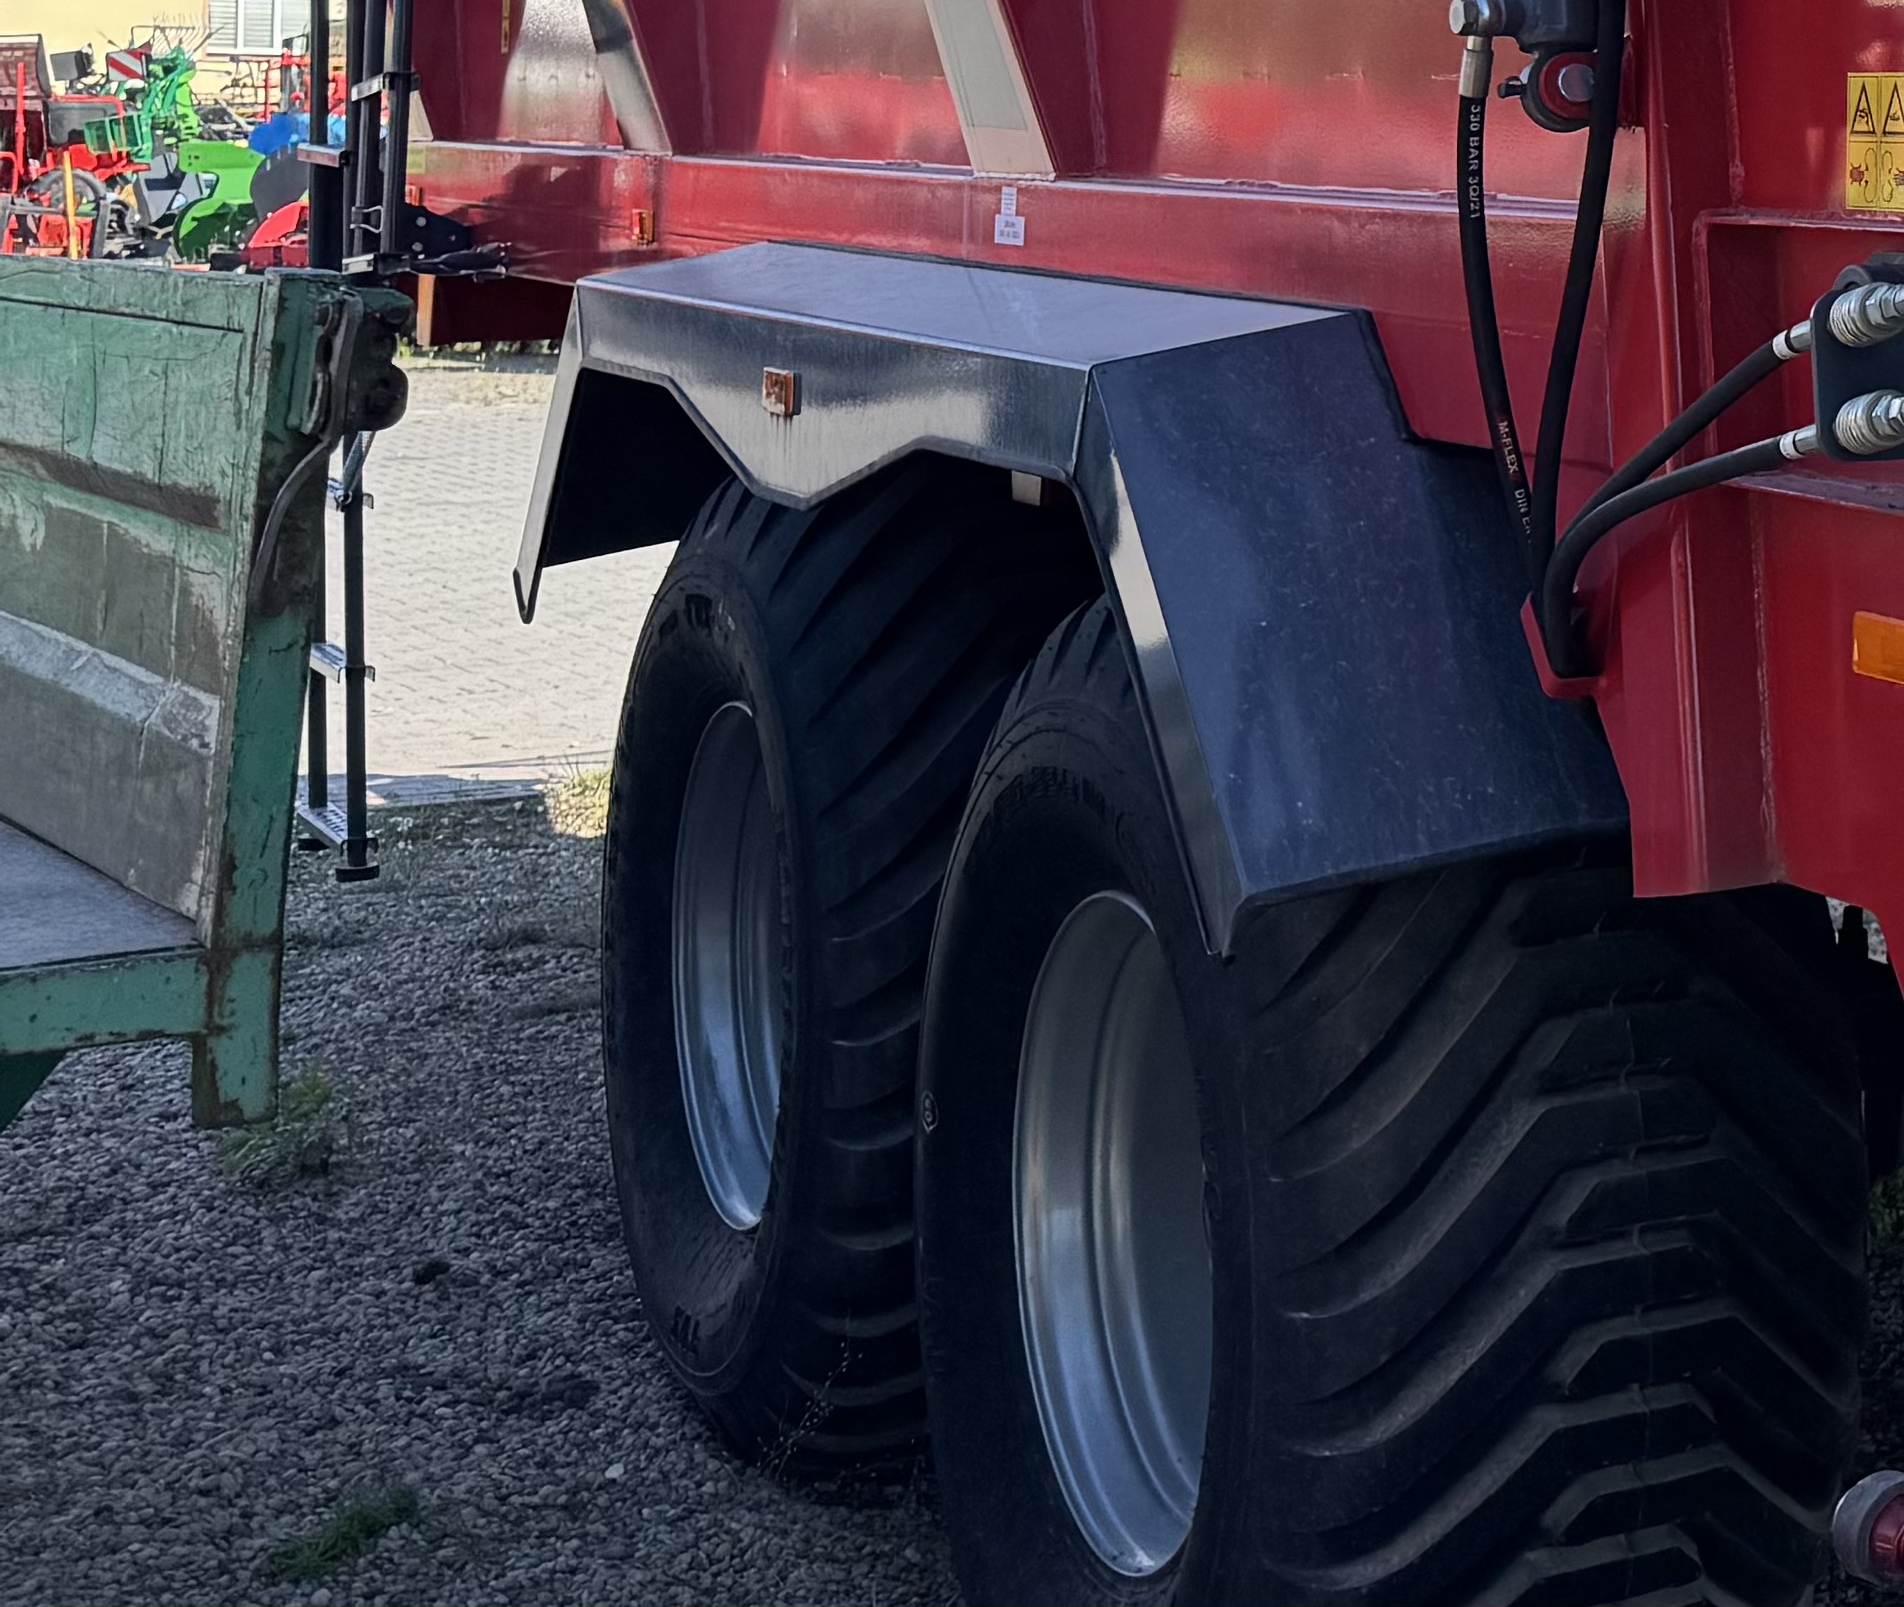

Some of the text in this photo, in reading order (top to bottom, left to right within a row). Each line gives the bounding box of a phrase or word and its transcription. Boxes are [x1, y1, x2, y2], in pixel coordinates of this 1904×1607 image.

[1469, 104, 1481, 131] 330
[1468, 137, 1480, 171] BAR
[1498, 421, 1519, 474] M-FLEX
[1514, 488, 1529, 513] DIN
